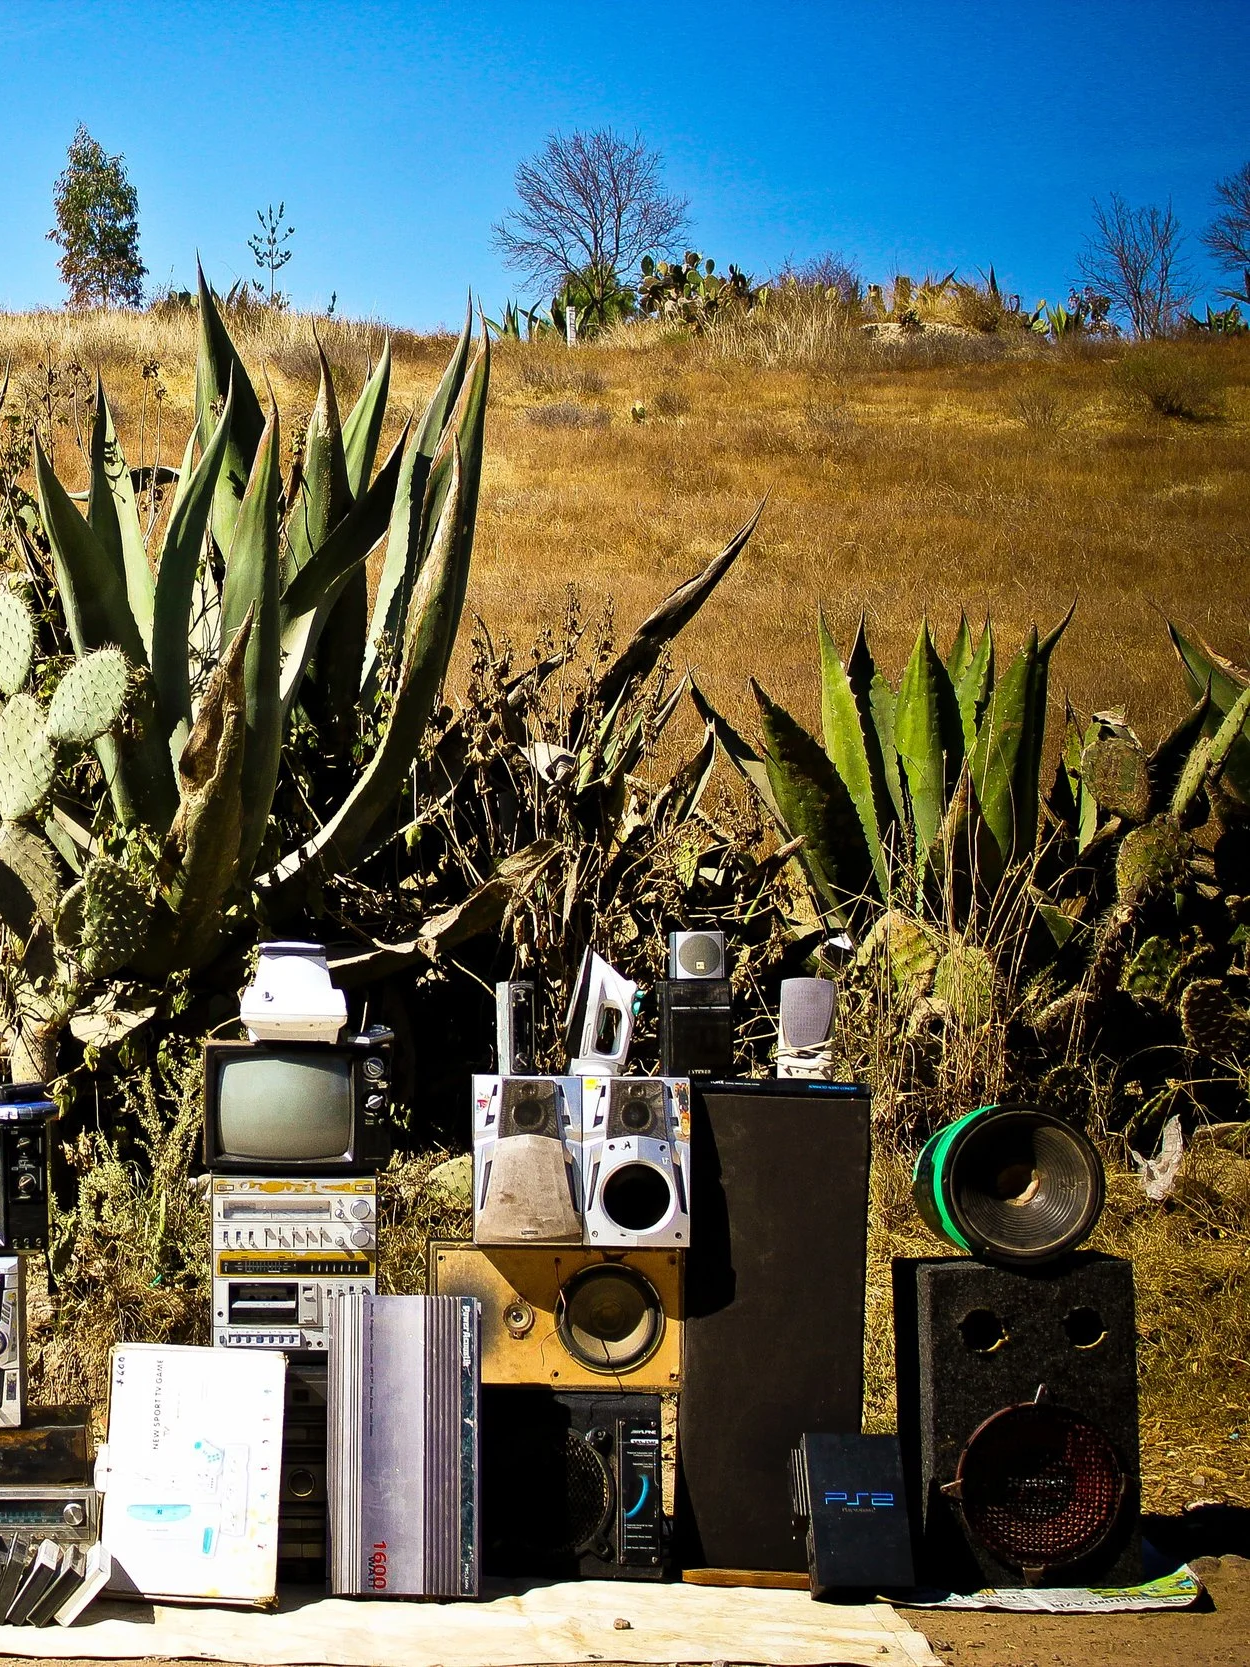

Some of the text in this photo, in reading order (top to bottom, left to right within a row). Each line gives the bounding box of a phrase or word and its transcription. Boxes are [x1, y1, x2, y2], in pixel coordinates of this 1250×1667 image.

[152, 1359, 164, 1450] NEW SPORT TV GAME
[824, 1491, 894, 1506] PS2
[367, 1556, 375, 1590] WATT
[372, 1540, 387, 1590] 1600
